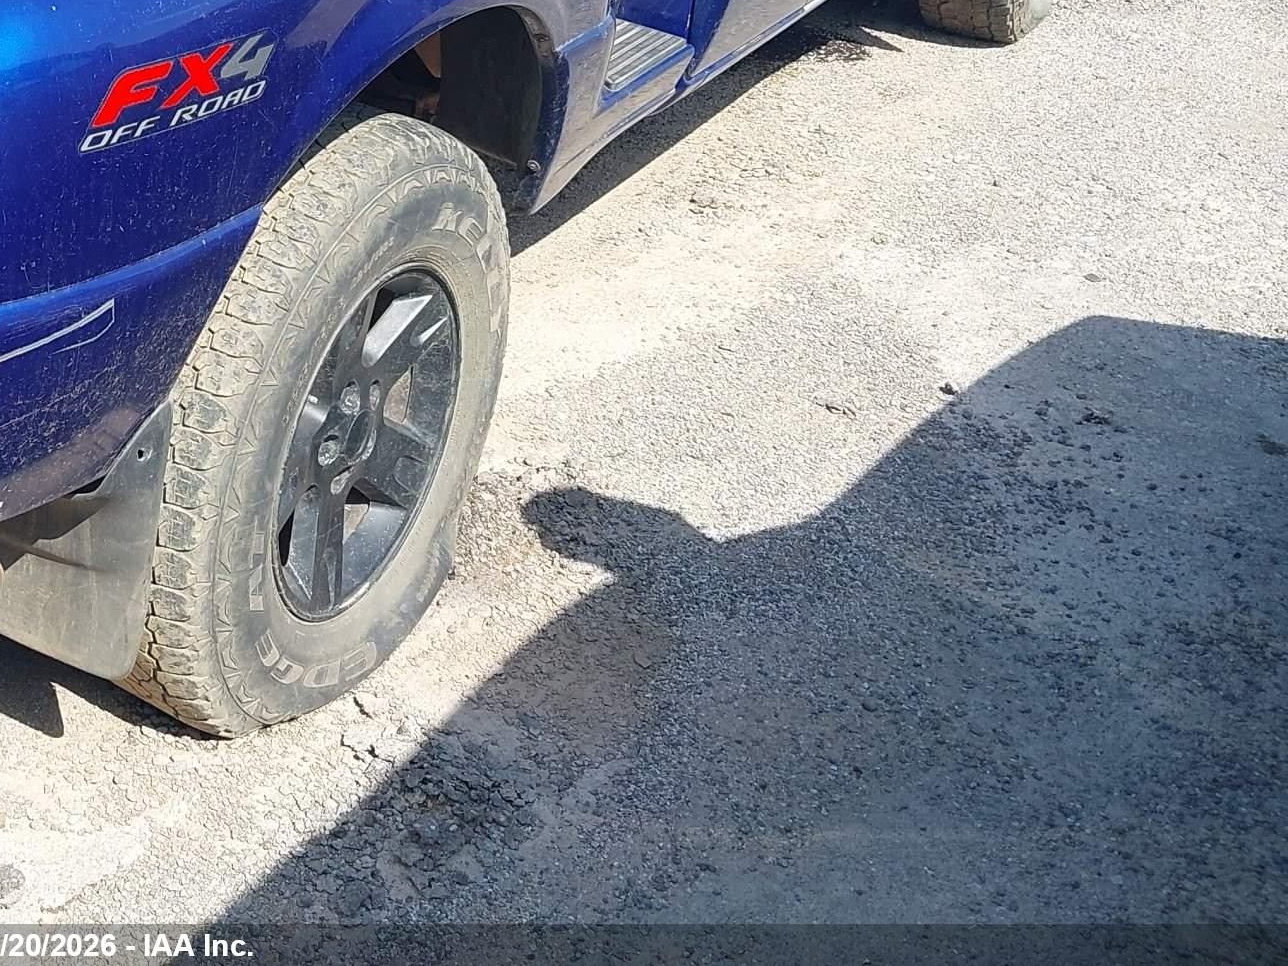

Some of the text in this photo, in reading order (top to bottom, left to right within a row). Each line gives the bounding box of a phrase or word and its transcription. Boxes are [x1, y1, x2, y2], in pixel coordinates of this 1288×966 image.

[80, 79, 267, 153] OFF ROAD
[92, 33, 275, 129] FX4
[254, 628, 379, 688] EDGE
